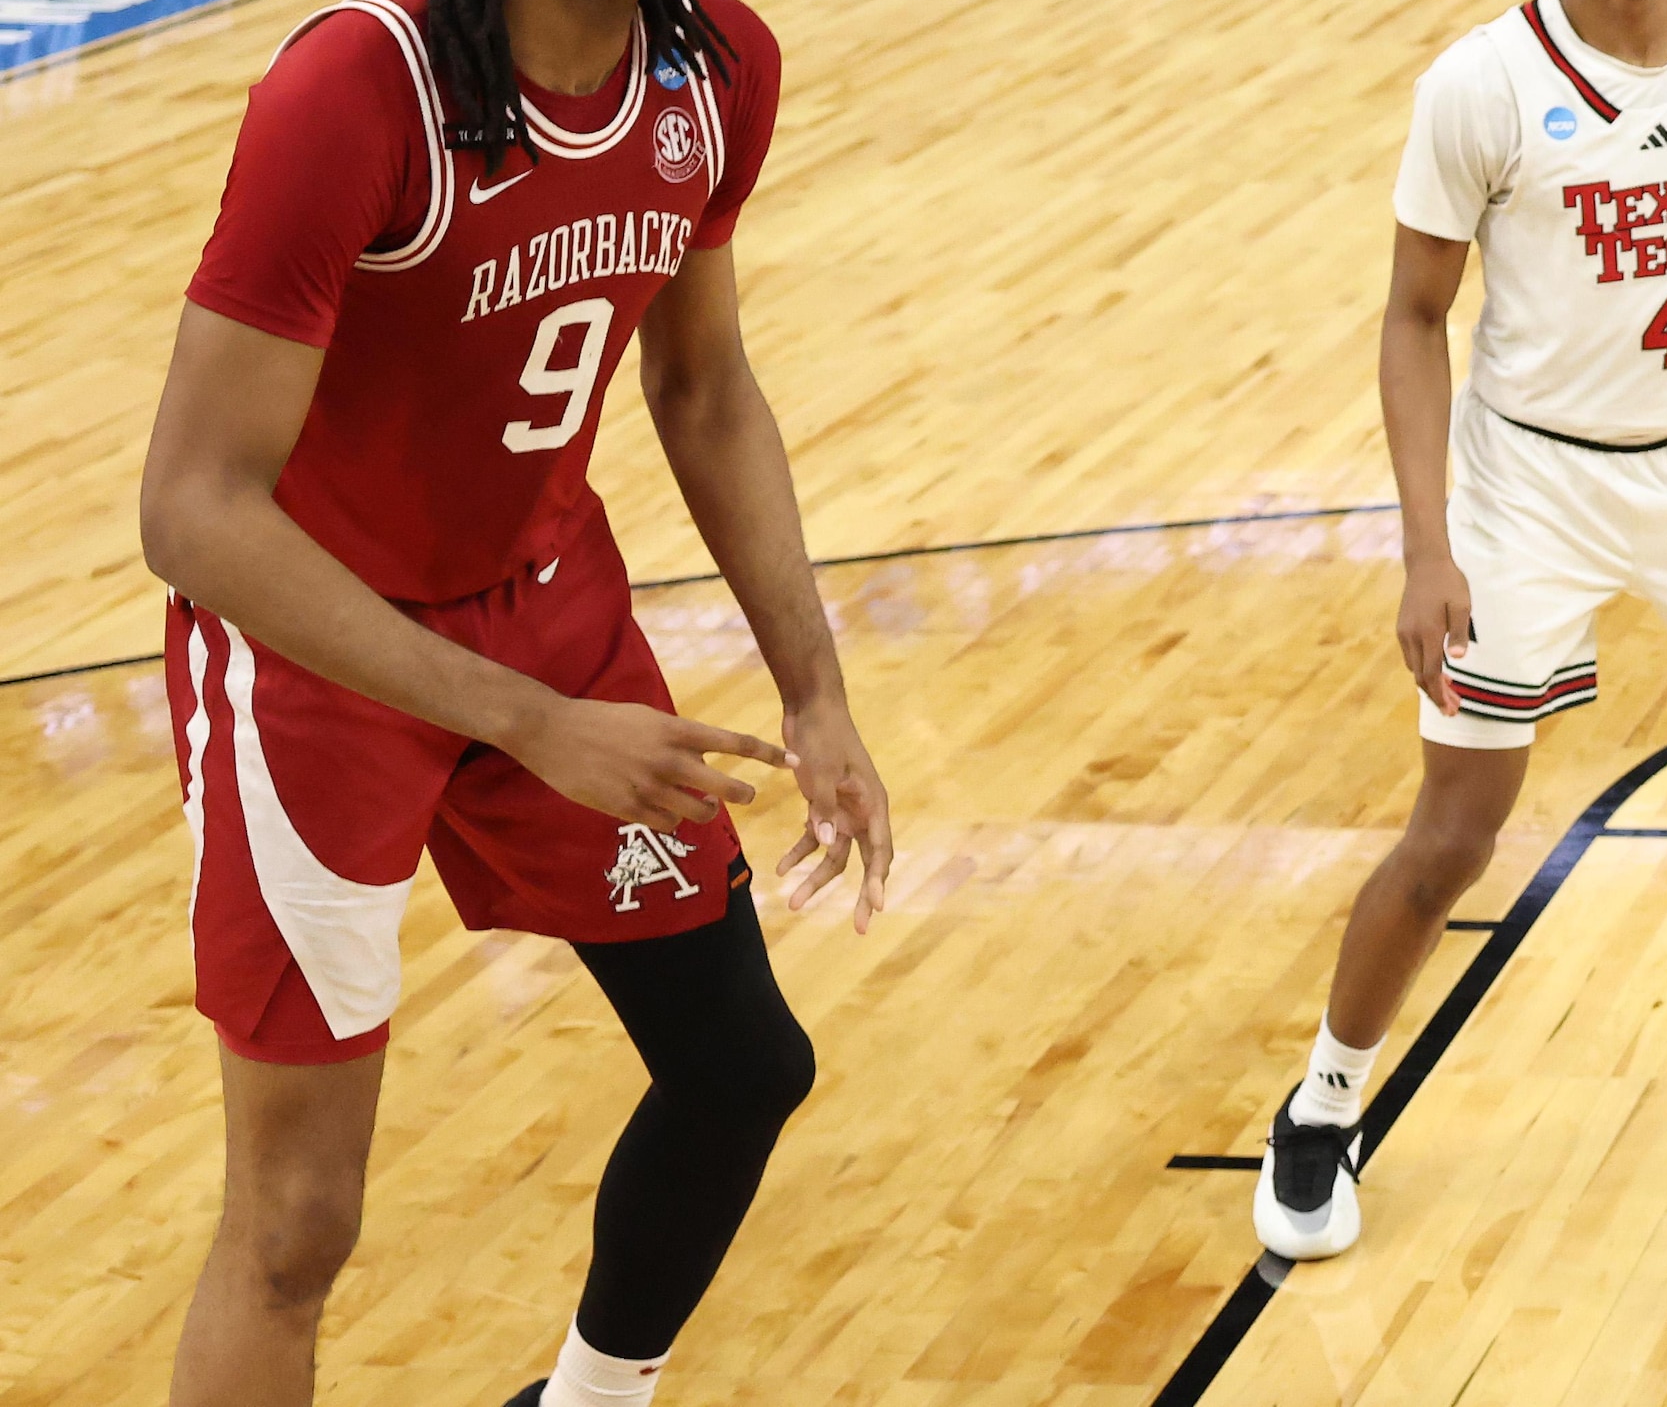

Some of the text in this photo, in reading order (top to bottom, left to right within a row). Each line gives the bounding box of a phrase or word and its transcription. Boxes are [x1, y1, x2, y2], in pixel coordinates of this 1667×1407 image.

[657, 113, 692, 162] SEC
[460, 210, 692, 324] RAZORBACKS
[502, 297, 615, 454] 9
